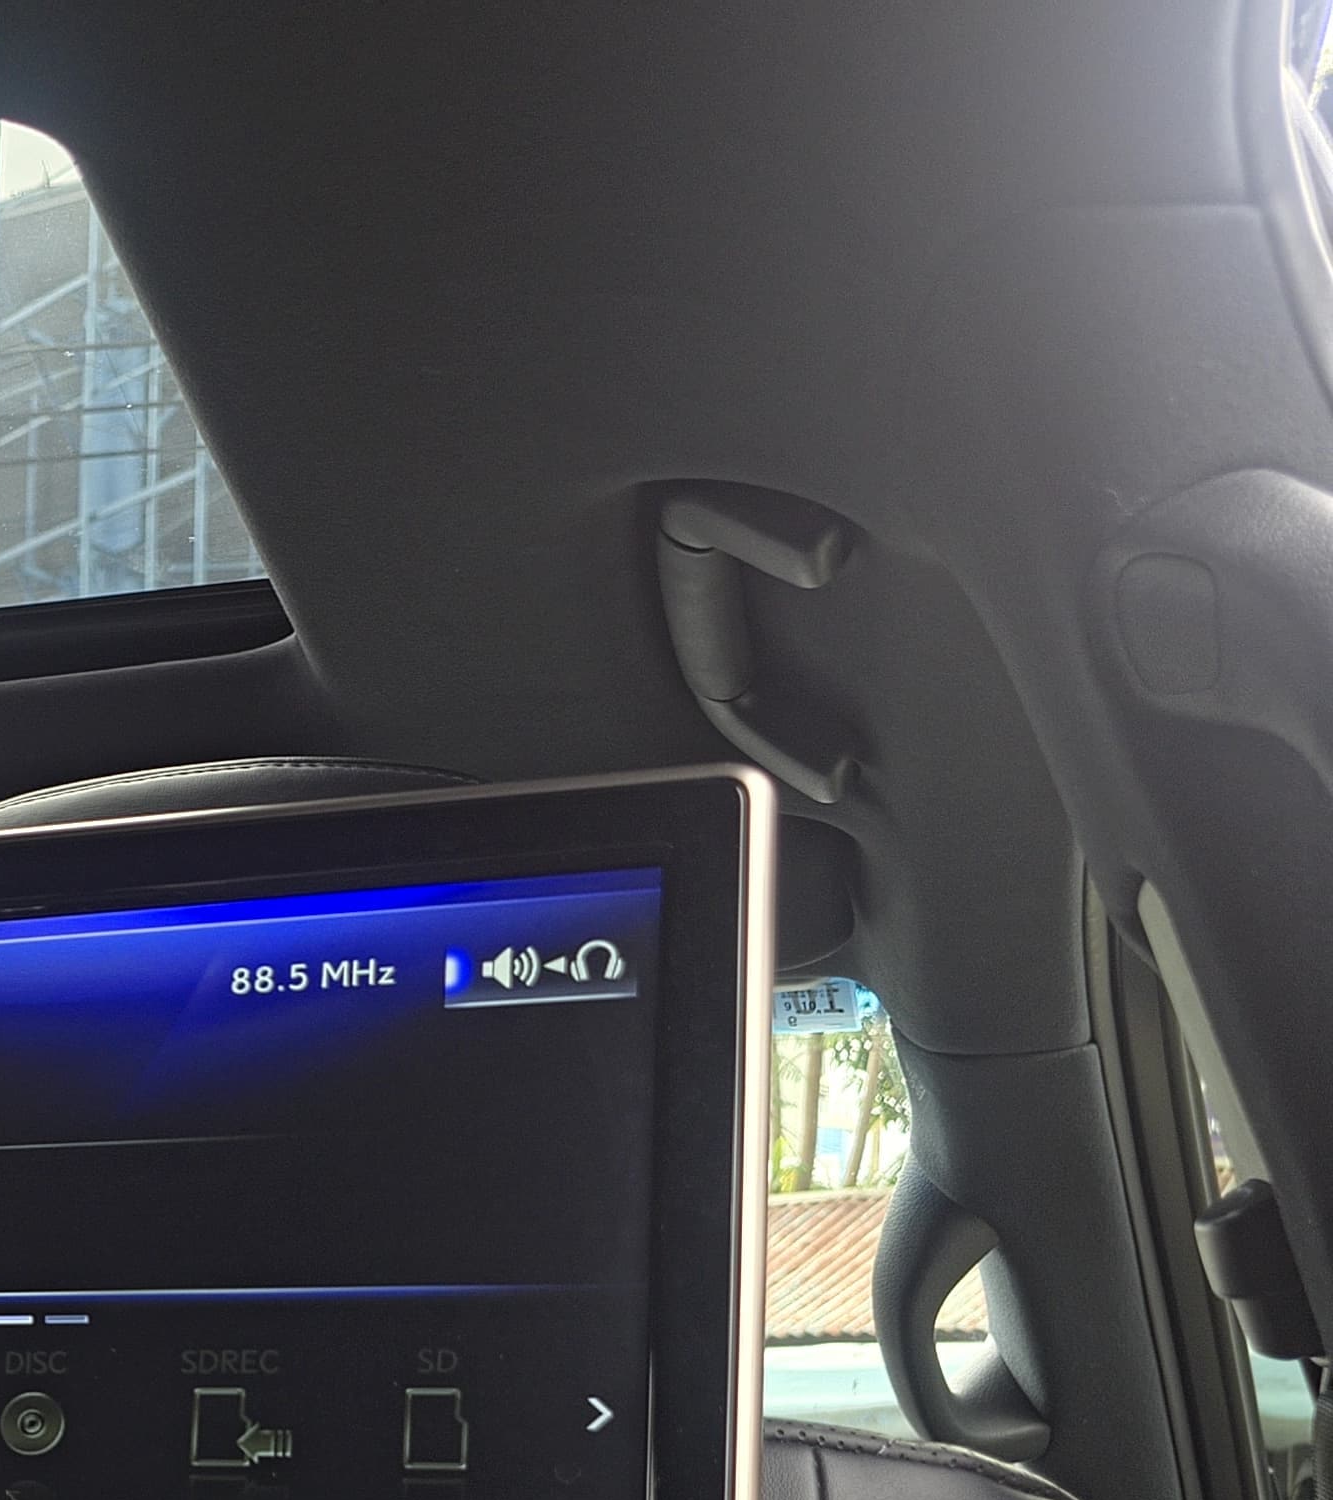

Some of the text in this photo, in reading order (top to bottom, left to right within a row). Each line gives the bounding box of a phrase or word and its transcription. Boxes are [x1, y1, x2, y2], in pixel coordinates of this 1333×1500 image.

[230, 957, 397, 996] 88.5 MHz
[5, 1350, 68, 1376] DISC
[181, 1349, 280, 1375] SDREC
[417, 1349, 460, 1375] SD
